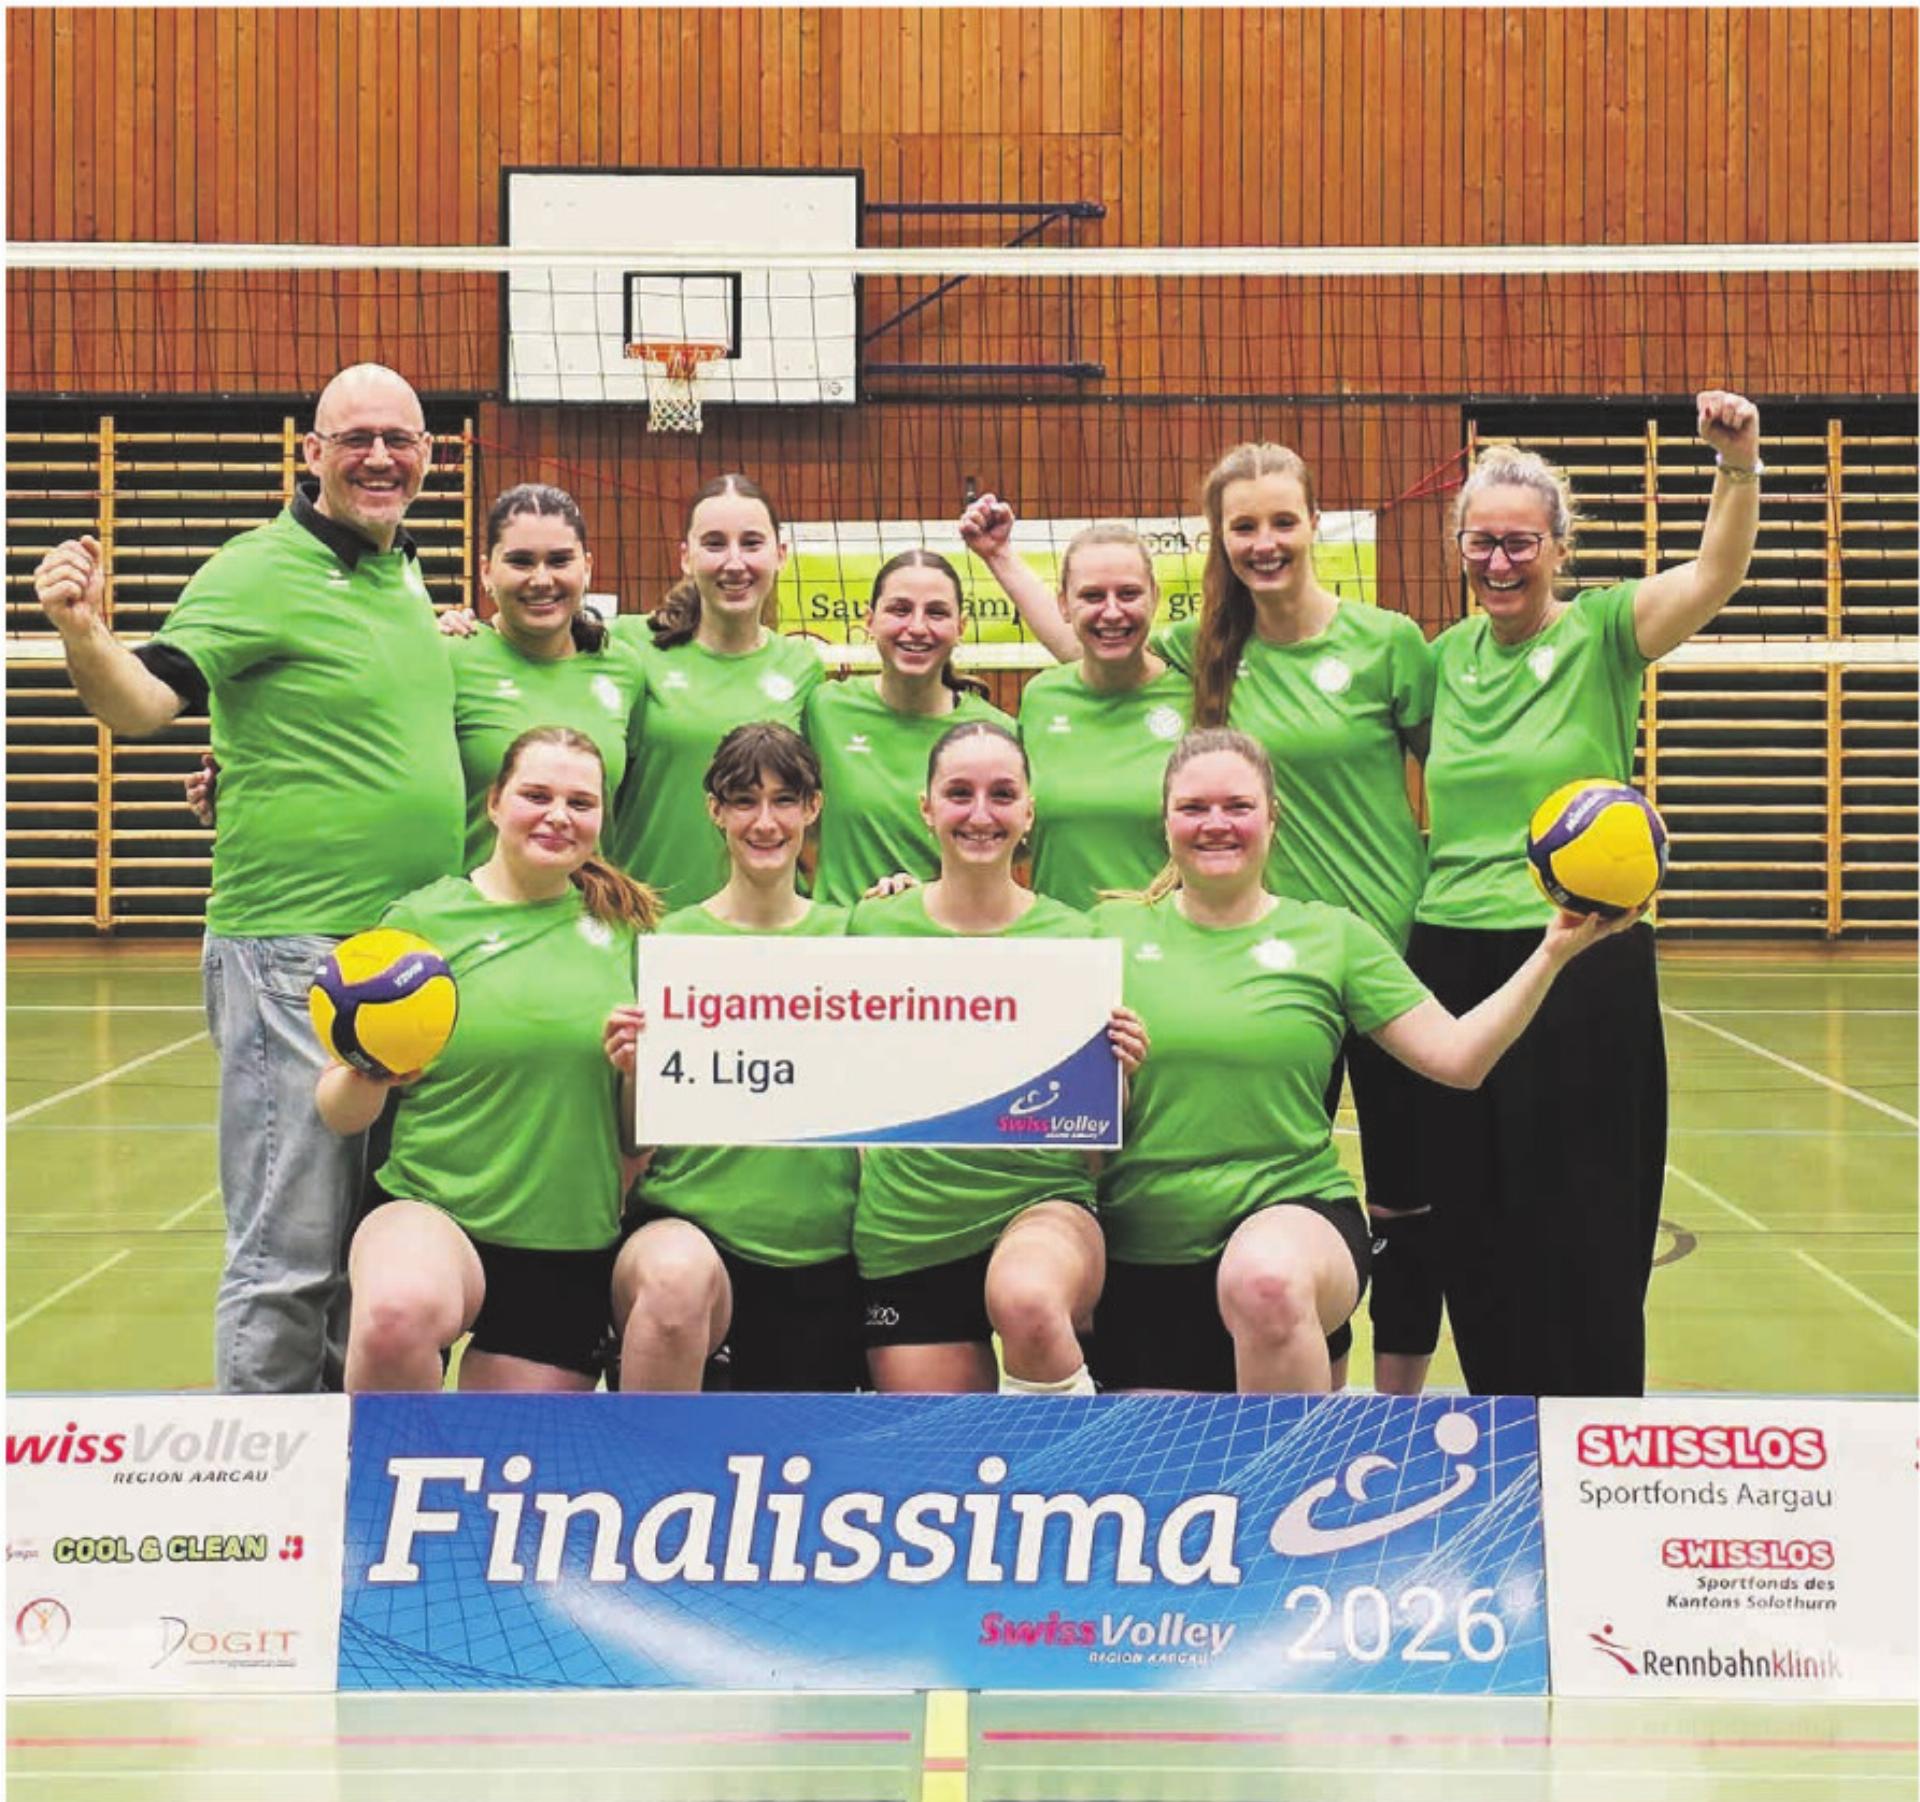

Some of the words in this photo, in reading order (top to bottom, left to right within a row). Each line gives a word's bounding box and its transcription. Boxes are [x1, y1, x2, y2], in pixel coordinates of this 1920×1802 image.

[1139, 532, 1191, 555] OOL
[811, 593, 869, 619] Sau
[661, 985, 1018, 1028] Ligameisterinnen
[659, 1050, 695, 1085] 4.
[712, 1049, 796, 1093] Liga
[6, 1418, 310, 1472] wissVolley
[1578, 1424, 1828, 1471] SWISSLOS
[113, 1472, 183, 1484] REGION
[189, 1470, 270, 1483] AARGAU
[1579, 1480, 1729, 1510] Sportfonds
[1737, 1482, 1833, 1513] Aargau
[366, 1454, 1242, 1586] Finalissima
[54, 1536, 135, 1564] COOL
[138, 1536, 164, 1563] &
[166, 1535, 268, 1562] CLEAN
[1662, 1538, 1836, 1570] SWISSLOS
[1696, 1576, 1799, 1594] Sportfonds
[1804, 1576, 1836, 1591] des
[1667, 1595, 1741, 1610] Kantons
[1746, 1595, 1838, 1611] Solothurn
[979, 1610, 1236, 1656] SwissVolley
[1282, 1585, 1506, 1663] 2026
[150, 1616, 300, 1669] DOGIT
[1642, 1648, 1844, 1679] Rennbahnklinik
